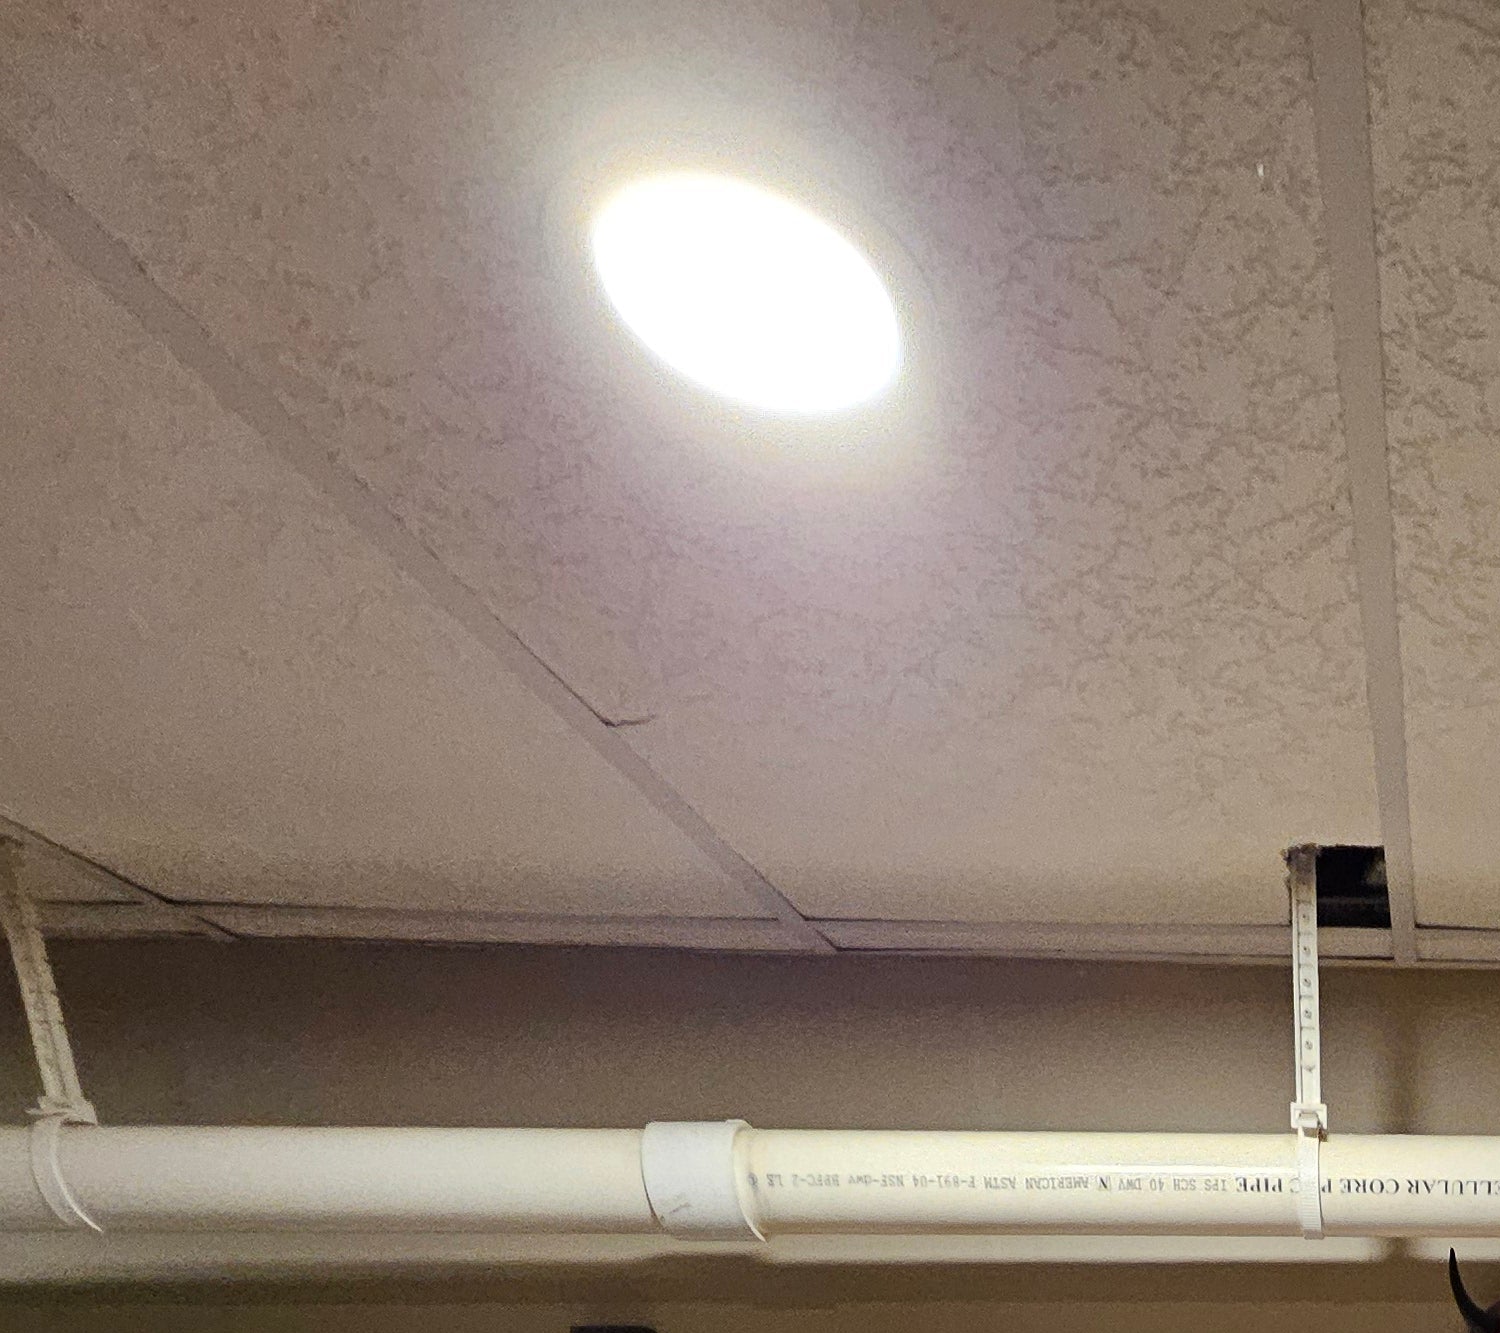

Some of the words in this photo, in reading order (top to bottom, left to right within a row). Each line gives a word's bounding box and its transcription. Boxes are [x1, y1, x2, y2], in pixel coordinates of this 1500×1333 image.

[983, 1175, 1016, 1189] ASTM
[1025, 1175, 1089, 1190] AMERICAN
[1117, 1177, 1142, 1191] DWV
[1149, 1177, 1164, 1191] 40
[1173, 1177, 1197, 1191] SCH
[1204, 1177, 1227, 1192] IPS
[1236, 1176, 1283, 1193] PIPE
[1289, 1178, 1332, 1194] PC
[1340, 1178, 1400, 1195] CORE
